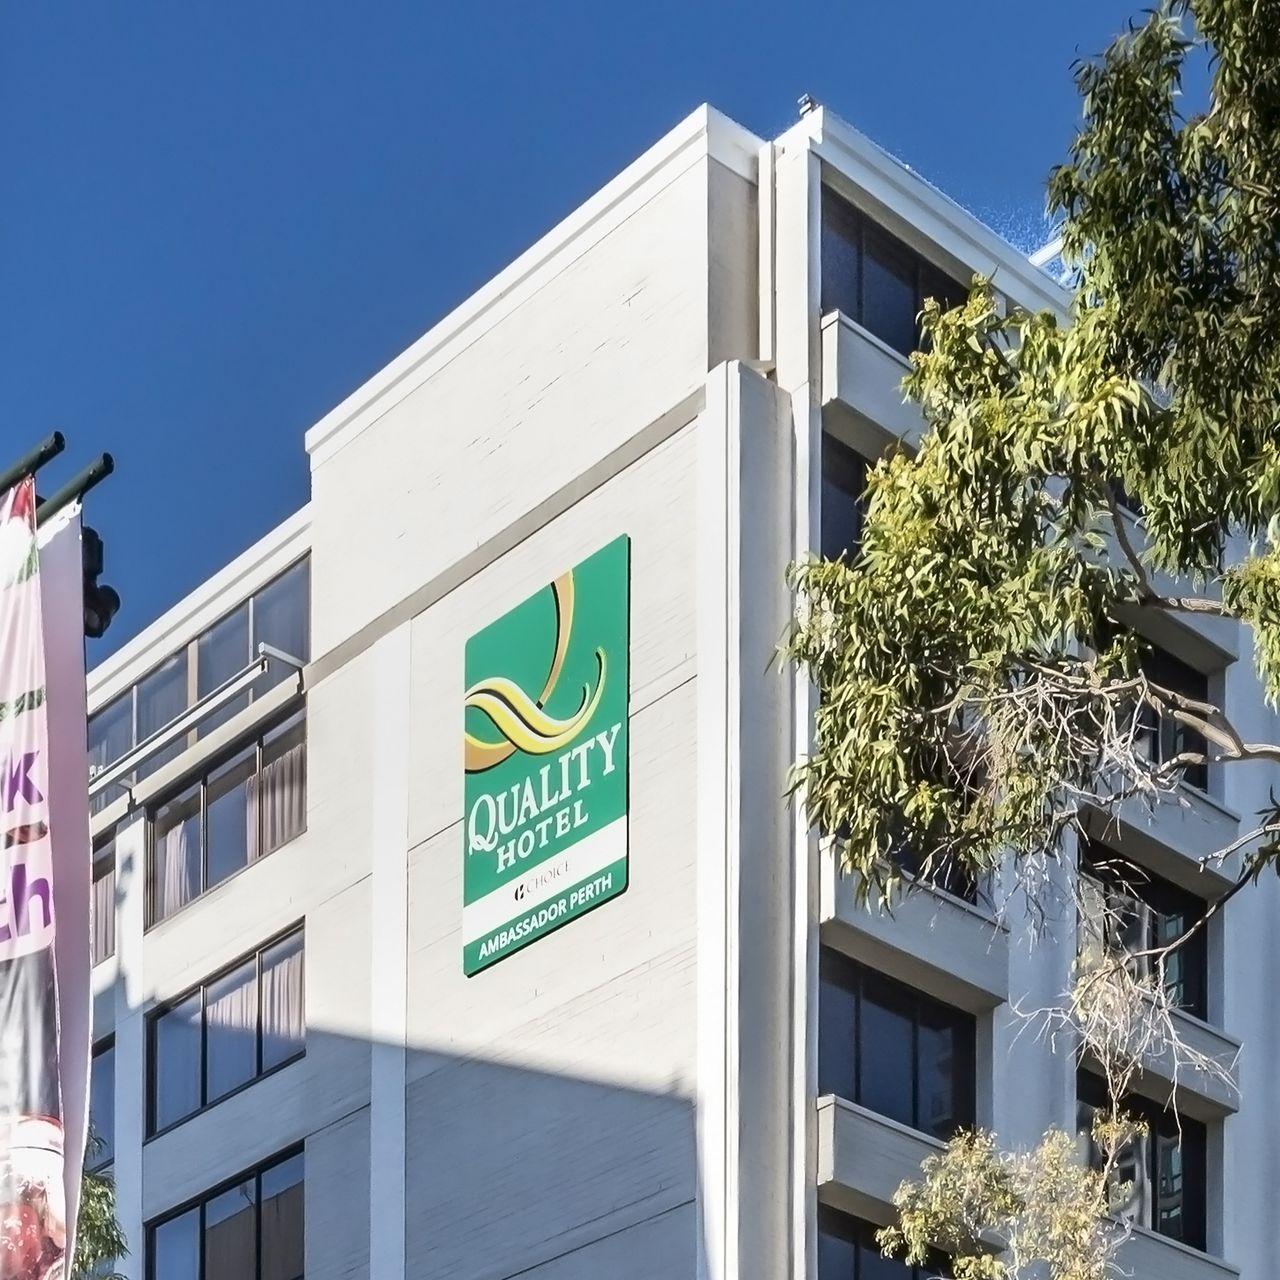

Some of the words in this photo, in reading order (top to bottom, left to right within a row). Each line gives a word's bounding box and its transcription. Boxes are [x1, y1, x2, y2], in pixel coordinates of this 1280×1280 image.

[468, 722, 622, 856] QUALITY
[496, 800, 589, 875] HOTEL
[478, 896, 568, 960] AMBASSADOR
[569, 872, 613, 911] PERTH
